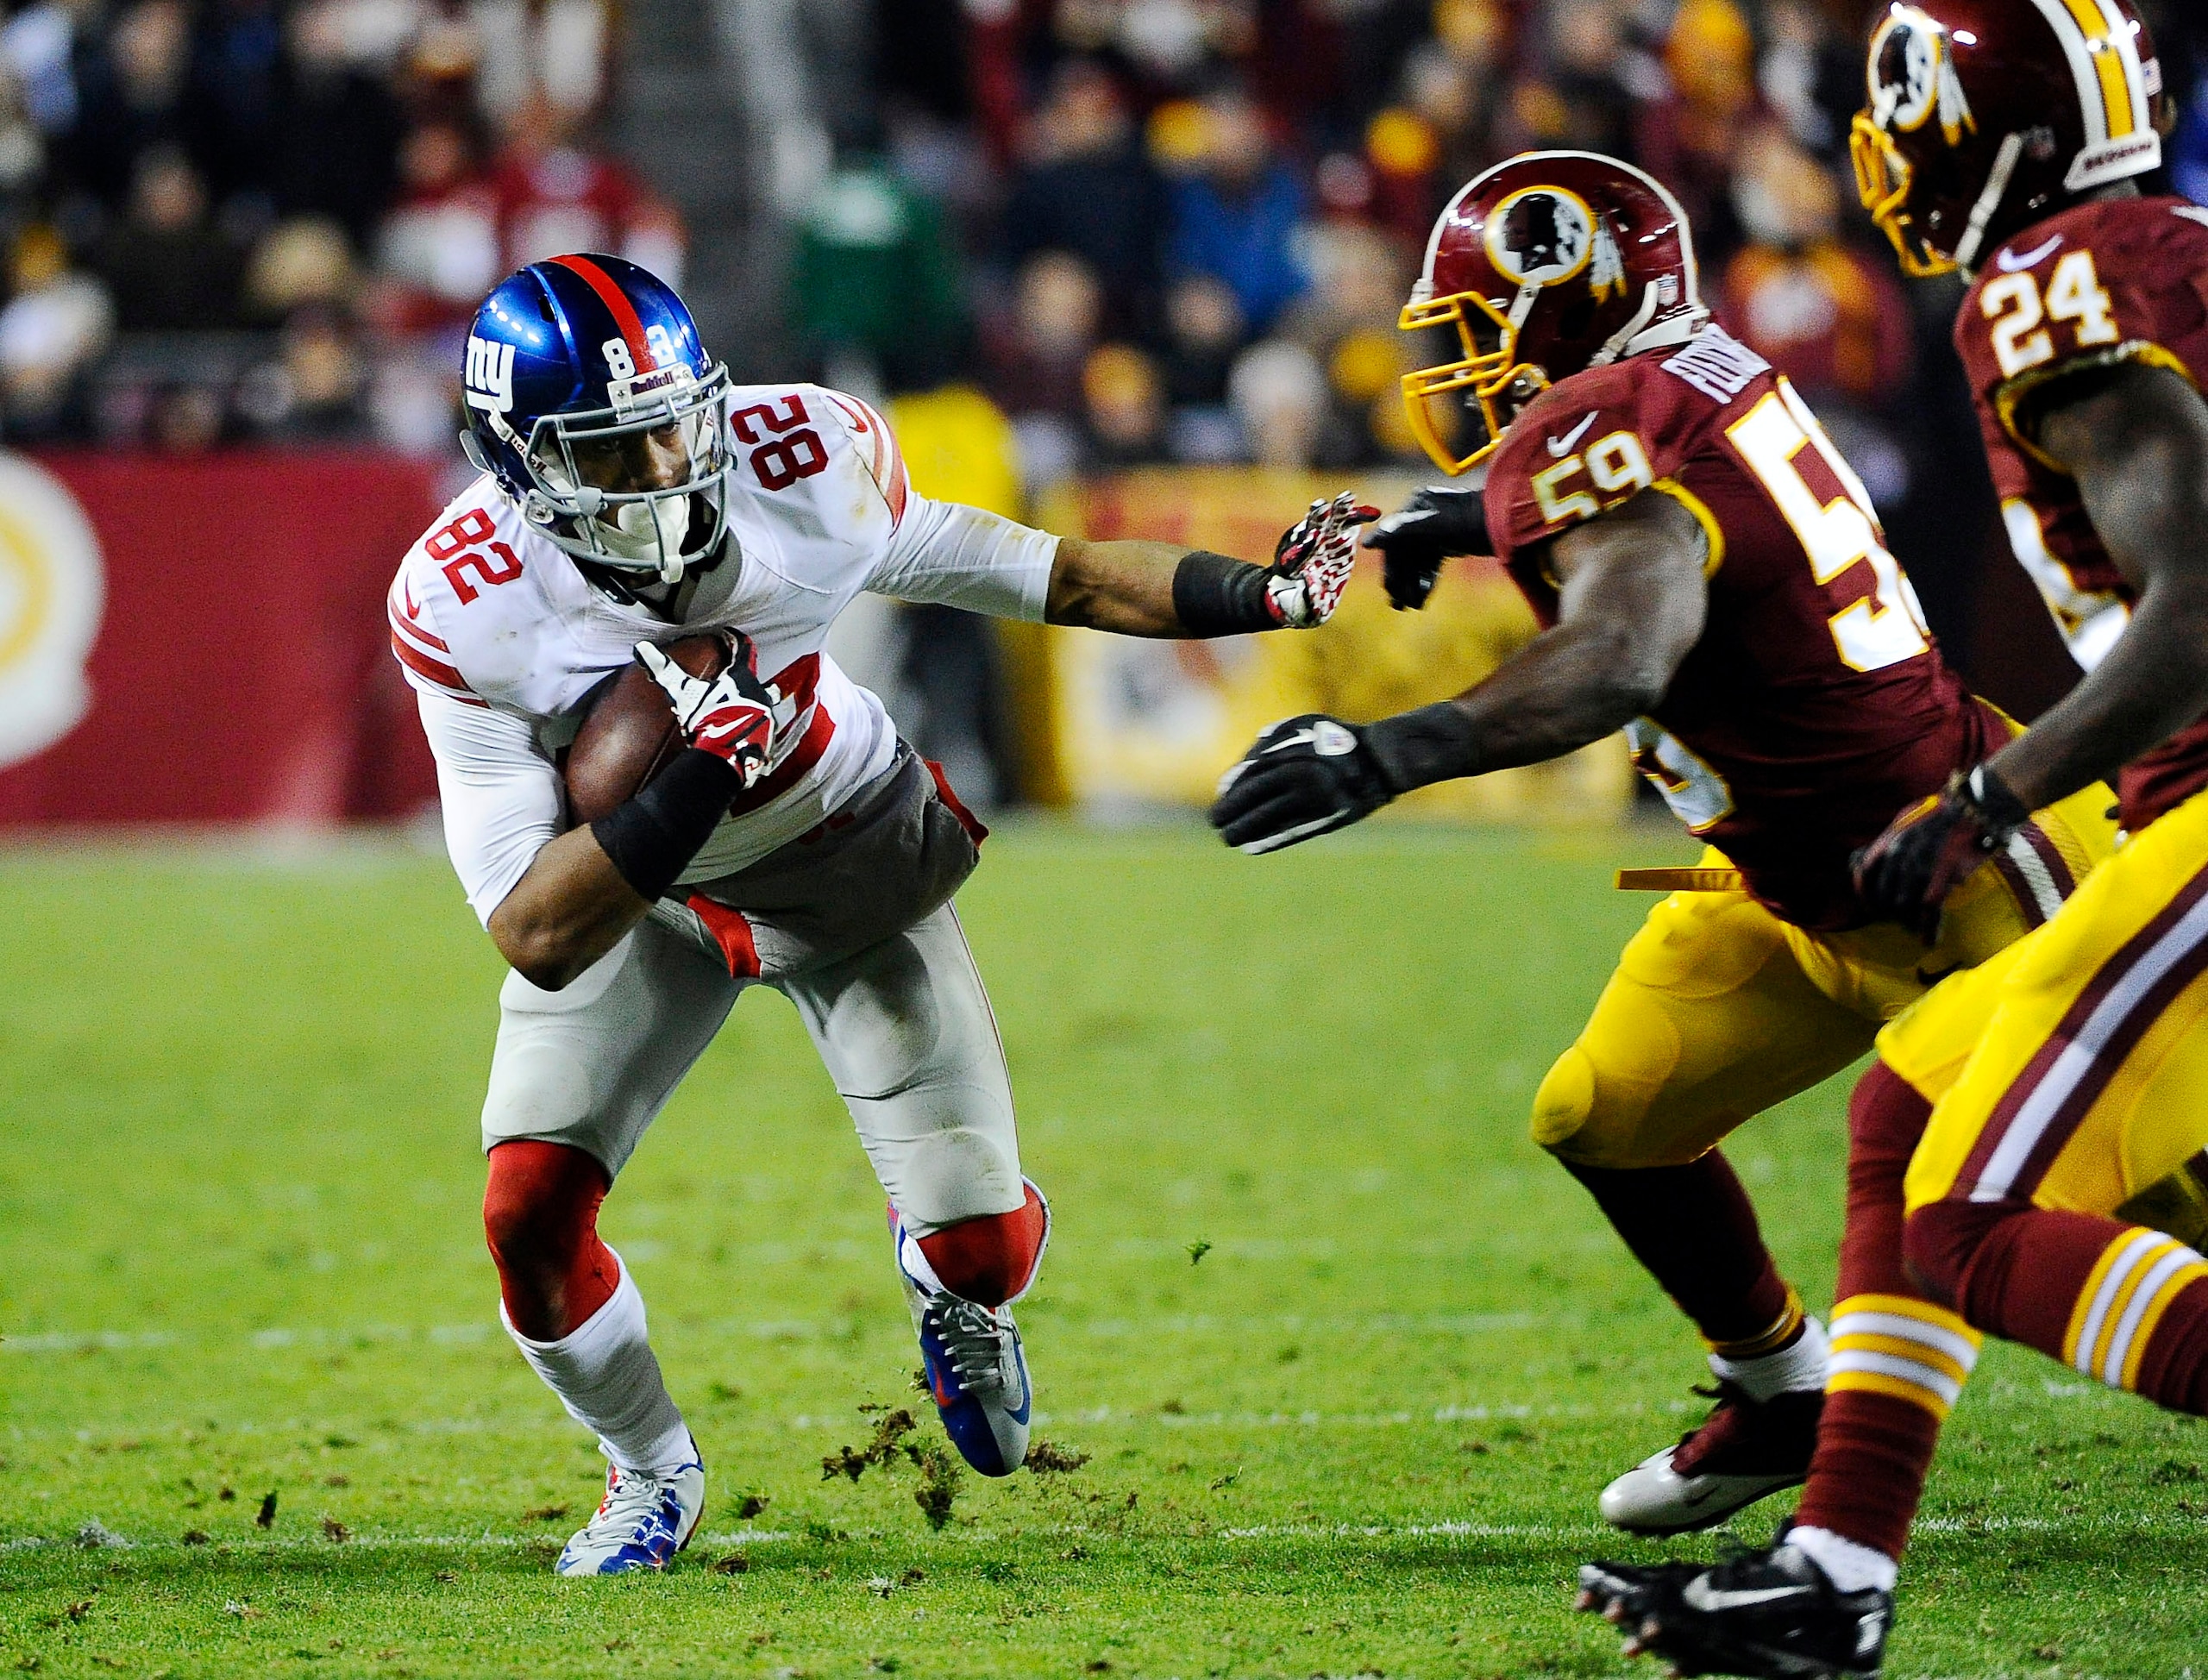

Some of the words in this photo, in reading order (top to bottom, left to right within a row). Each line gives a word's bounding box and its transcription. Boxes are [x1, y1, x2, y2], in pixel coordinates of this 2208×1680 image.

[1979, 248, 2119, 378] 24
[730, 393, 830, 492] 82
[1531, 430, 1656, 524] 59
[424, 508, 524, 605] 82
[1725, 374, 1930, 673] 5
